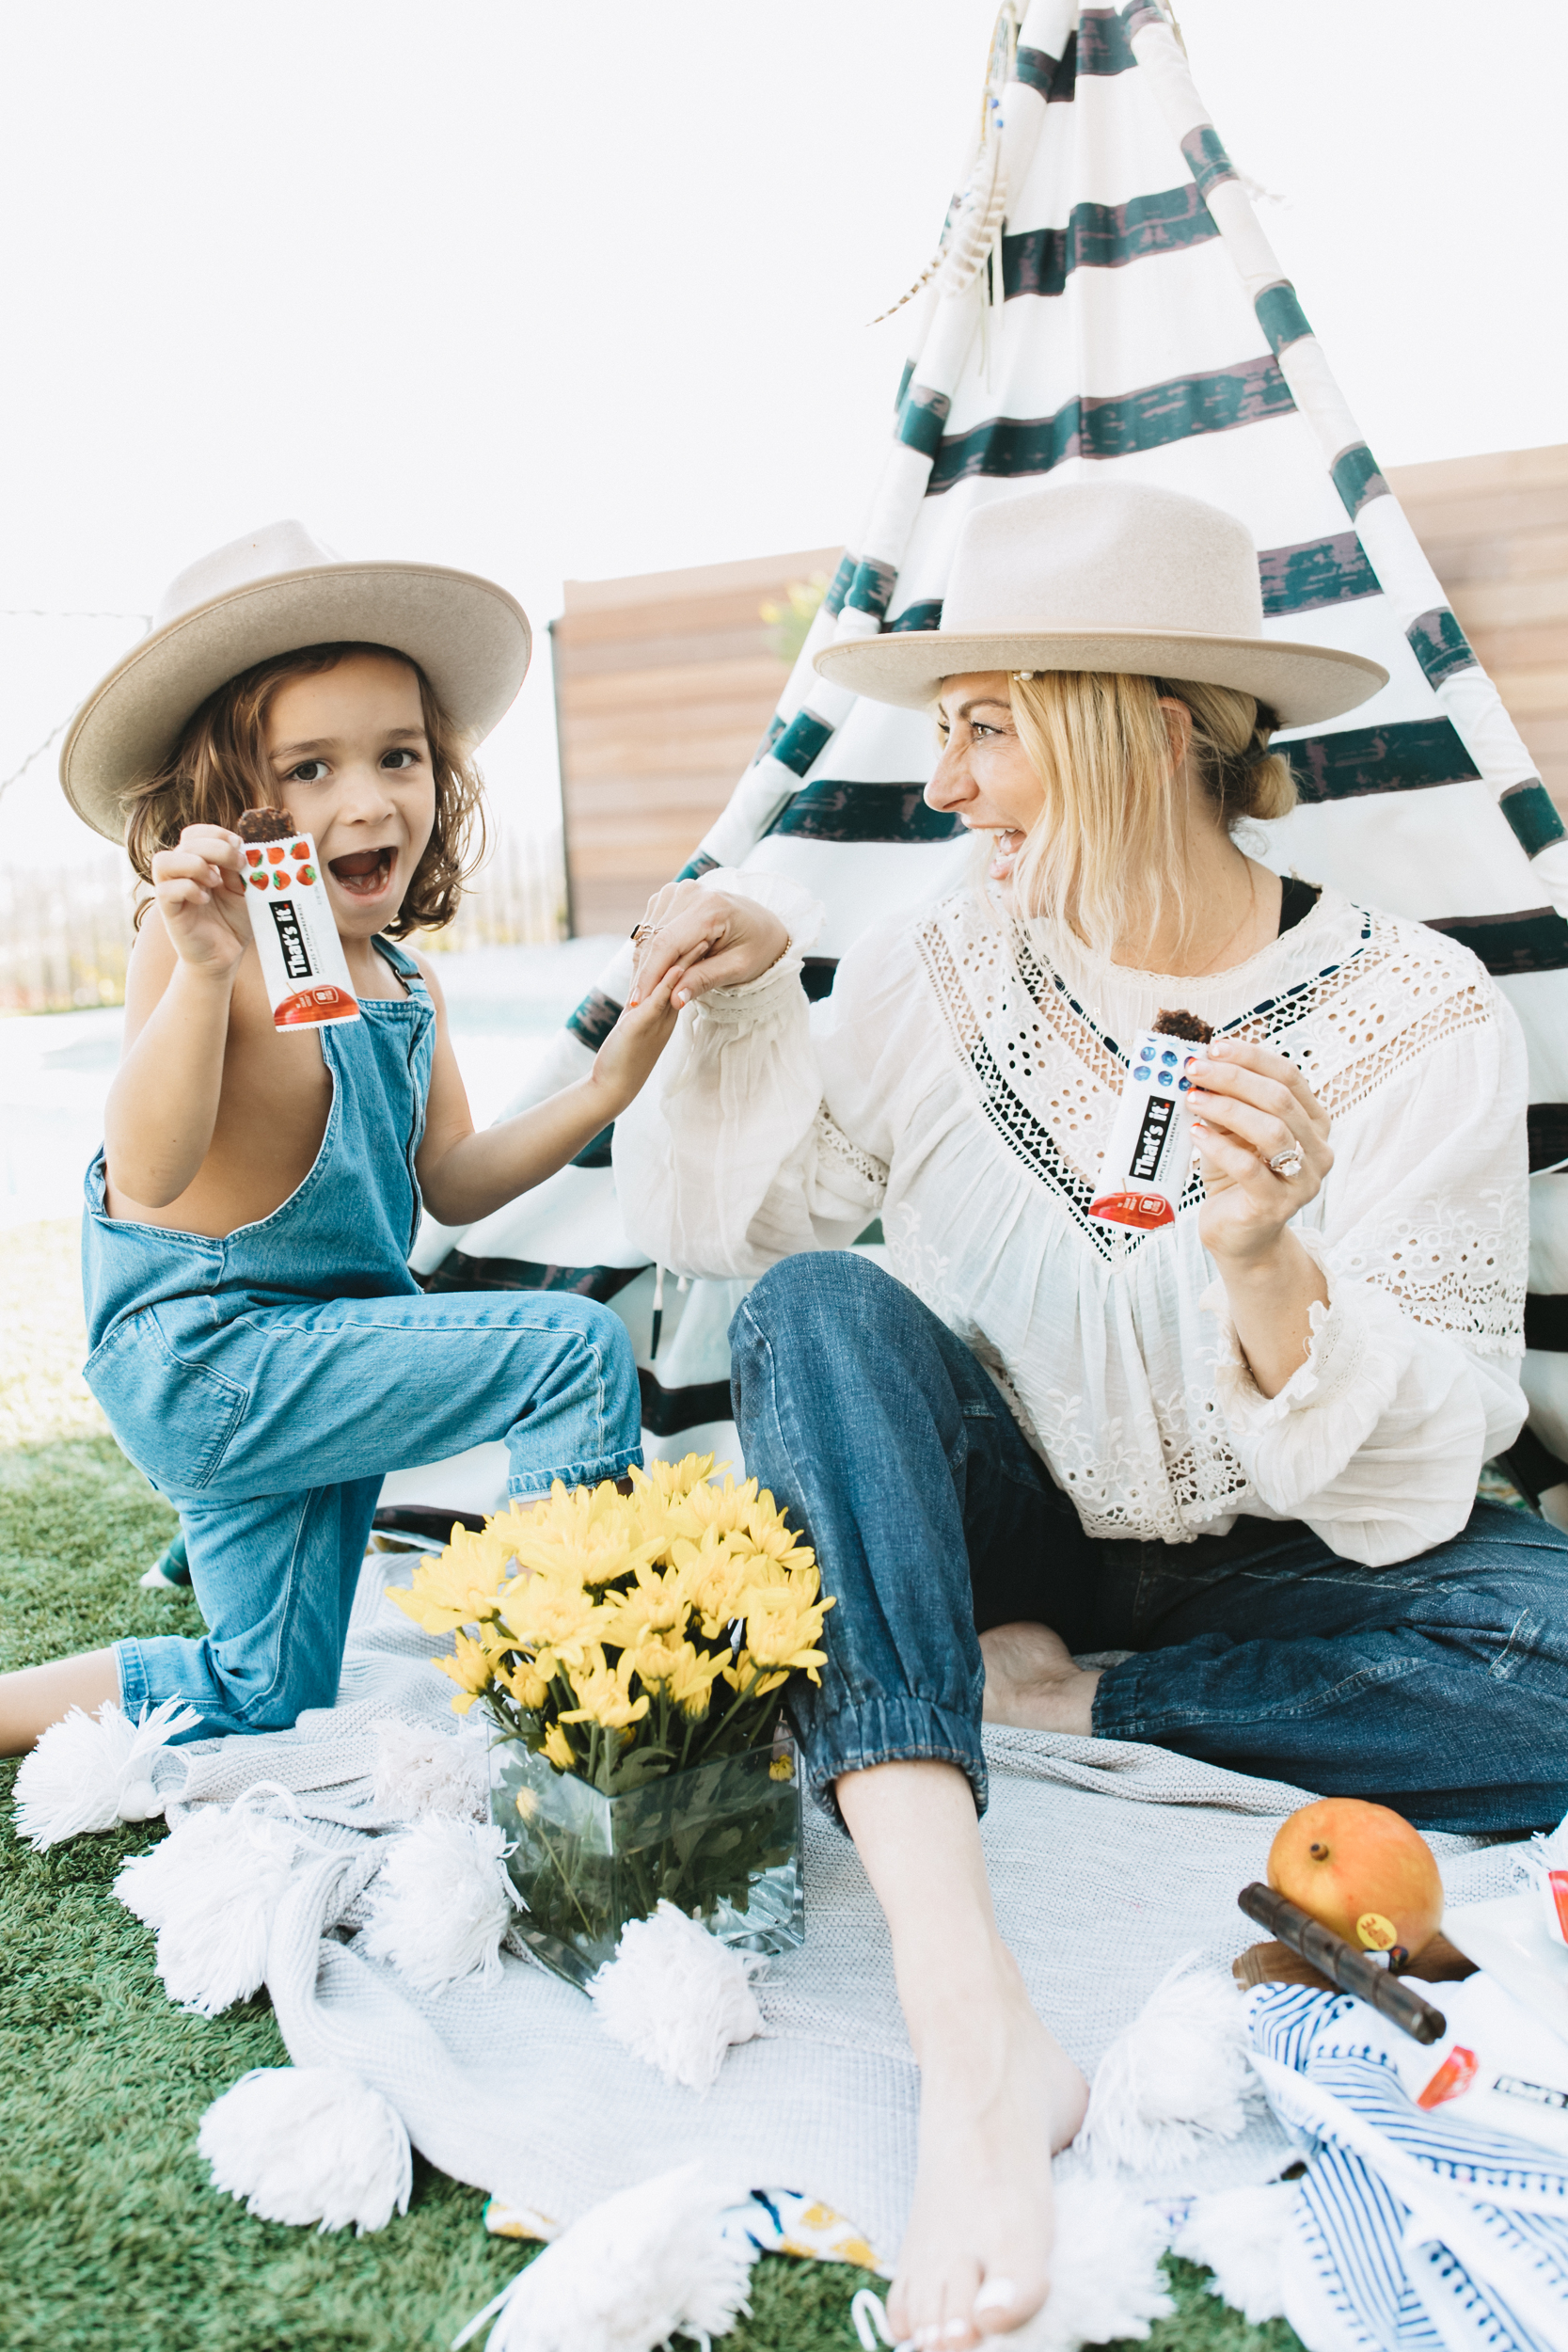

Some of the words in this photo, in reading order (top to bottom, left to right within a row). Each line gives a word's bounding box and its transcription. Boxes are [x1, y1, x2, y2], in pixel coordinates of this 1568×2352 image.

[297, 903, 312, 947] STRAWBERRIES
[282, 926, 308, 977] That's
[311, 953, 320, 974] APPLES
[1134, 1125, 1164, 1175] That's
[1158, 1160, 1167, 1181] APPLES
[1166, 1113, 1180, 1152] BLUEBERRIES
